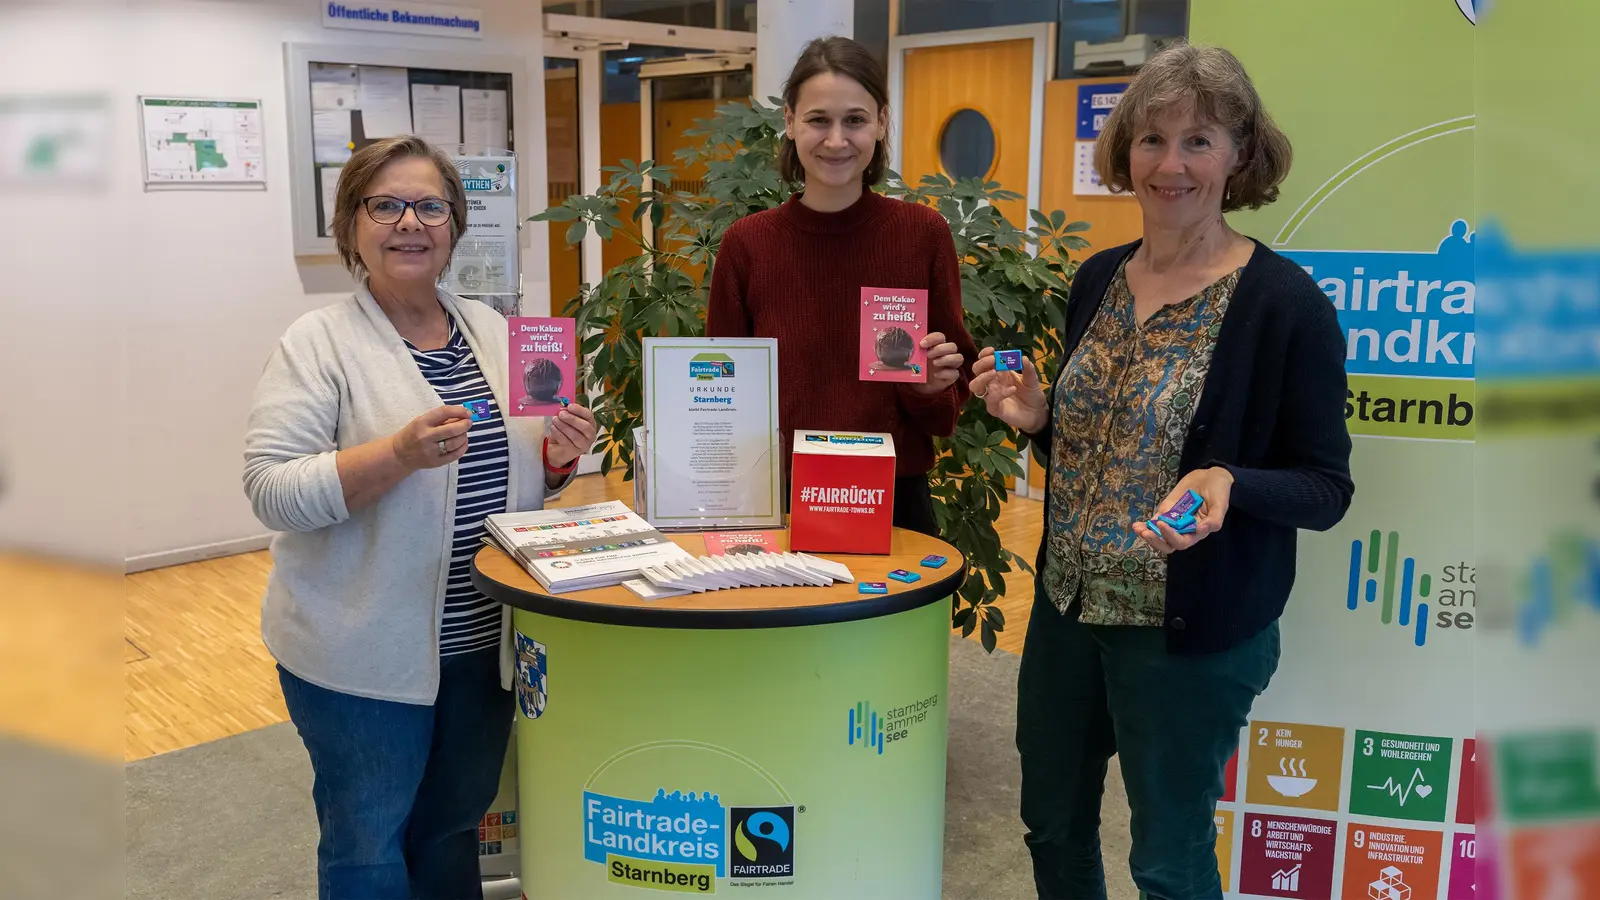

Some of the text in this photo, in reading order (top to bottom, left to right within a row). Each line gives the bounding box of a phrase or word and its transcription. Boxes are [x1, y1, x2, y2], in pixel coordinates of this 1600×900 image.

[328, 4, 480, 32] Öffentliche Bekanntmachung
[1301, 265, 1475, 315] airtra
[892, 295, 916, 303] Kakao
[882, 303, 906, 311] wird's
[873, 311, 916, 322] zu heiß!
[520, 324, 563, 333] Dem Kakao
[530, 333, 554, 341] wird's
[520, 342, 563, 353] zu heiß!
[693, 395, 732, 405] Starnberg
[800, 485, 885, 505] #FAIRRÜCKT
[809, 505, 875, 514] WWW.FAIRTRADE-TOWNS.DE
[886, 693, 939, 720] starnberg
[886, 710, 928, 732] ammer
[886, 729, 908, 743] see
[1257, 727, 1269, 746] 2
[1275, 728, 1292, 738] KEIN
[1275, 738, 1303, 749] HUNGER
[1362, 737, 1374, 756] 3
[1381, 738, 1440, 752] GESUNDHEIT UND
[1380, 749, 1432, 761] WOHLERGEHEN
[587, 798, 720, 835] Fairtrade-
[1251, 819, 1262, 838] 8
[1267, 820, 1332, 836] MENSCHENWÜRDIGE
[588, 821, 720, 859] Landkreis
[1266, 830, 1304, 841] ARBEIT UND
[1353, 829, 1365, 849] 9
[1265, 840, 1314, 852] WIRTSCHAFTS-
[1368, 841, 1425, 855] INNOVATION UND
[1459, 839, 1475, 859] 10
[1265, 849, 1303, 861] WACHSTUM
[1367, 851, 1424, 865] INFRASTRUKTUR
[611, 860, 710, 891] Starnberg
[733, 864, 790, 874] FAIRTRADE
